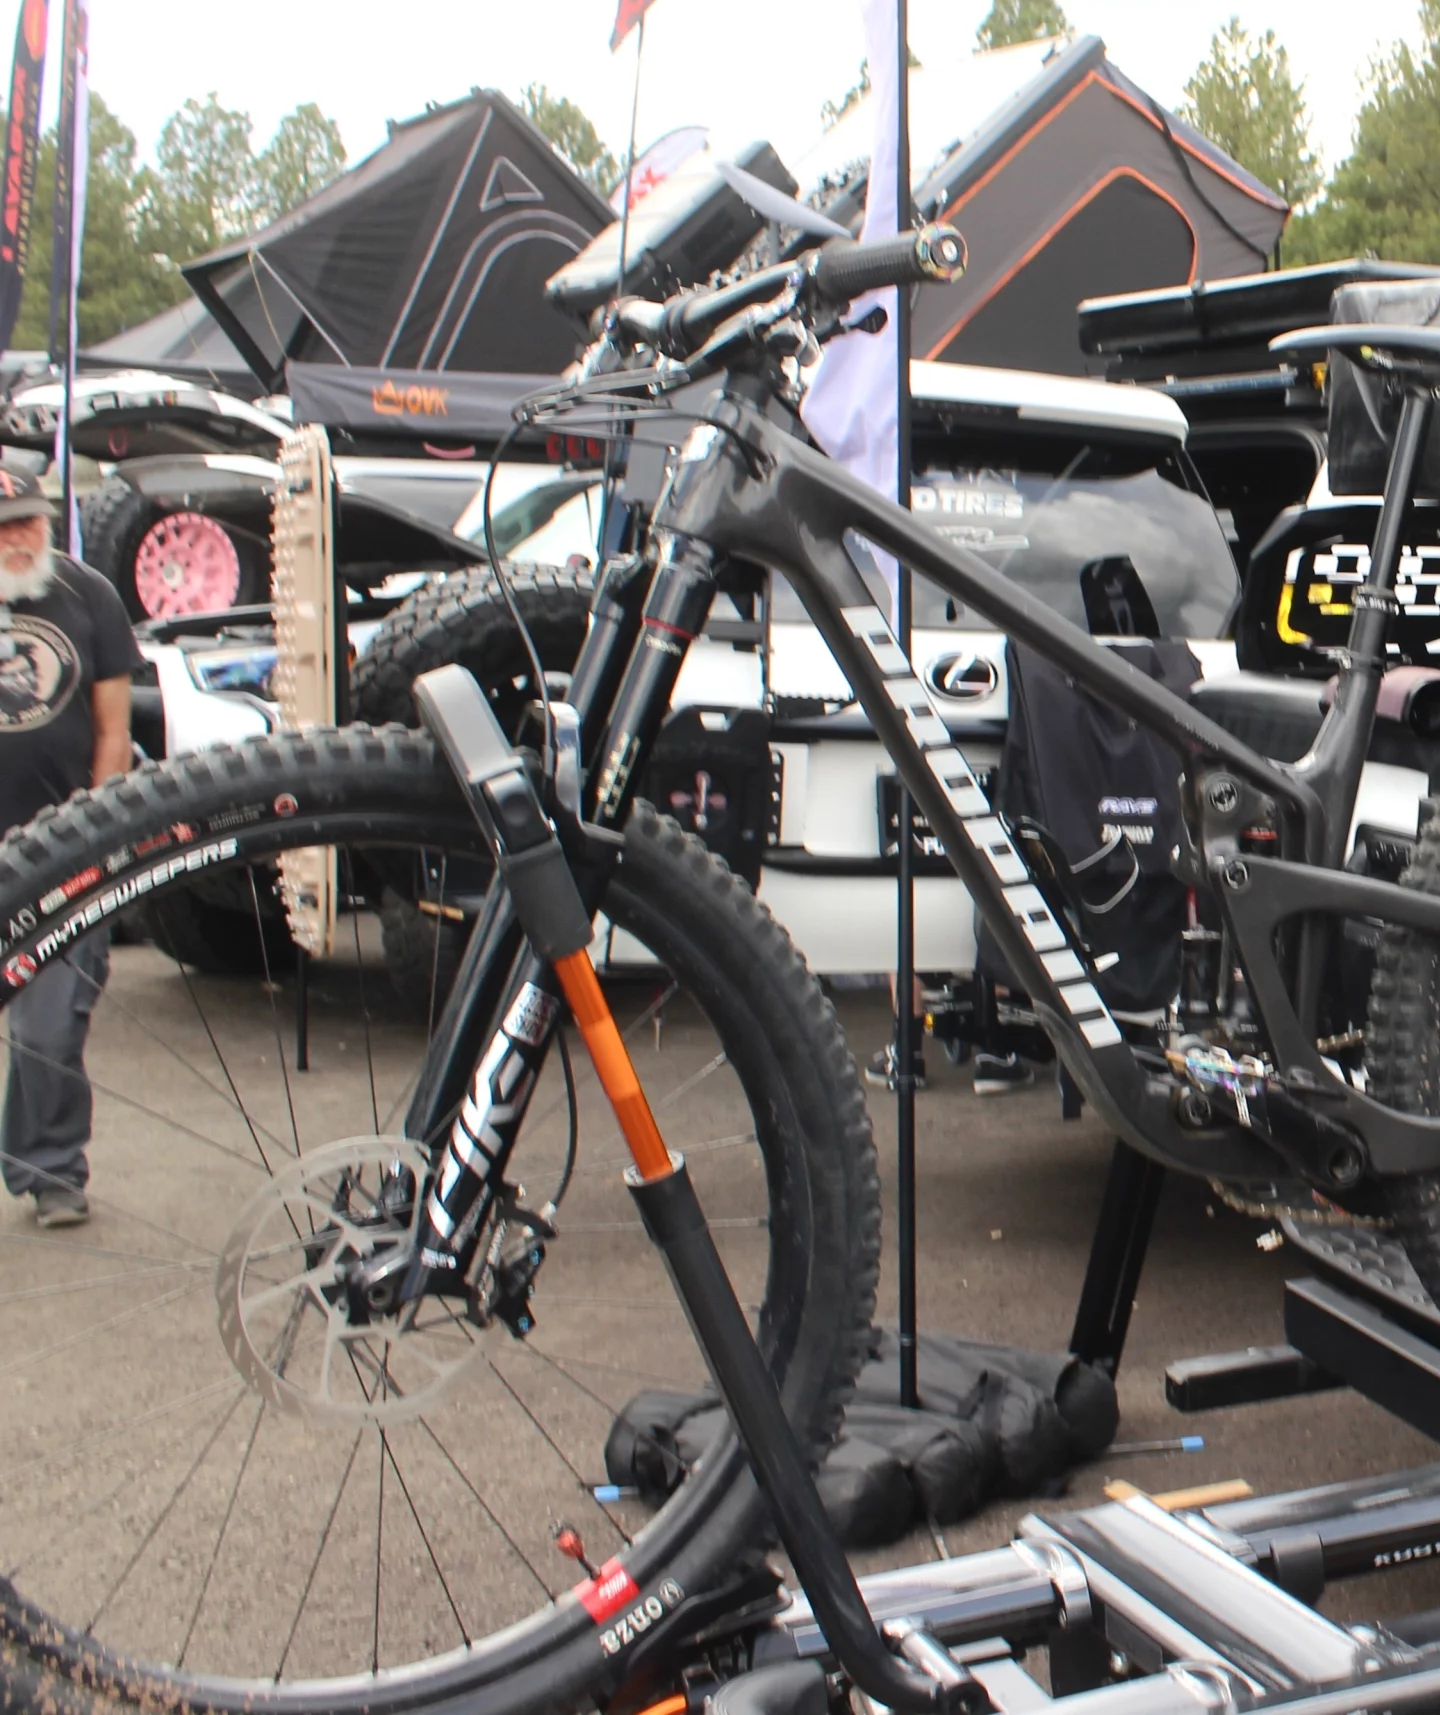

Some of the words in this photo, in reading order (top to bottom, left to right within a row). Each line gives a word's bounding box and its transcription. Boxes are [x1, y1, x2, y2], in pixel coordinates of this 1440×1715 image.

[939, 488, 1023, 519] TIRES
[839, 605, 1122, 1049] PROPAIN
[599, 1595, 663, 1655] onza
